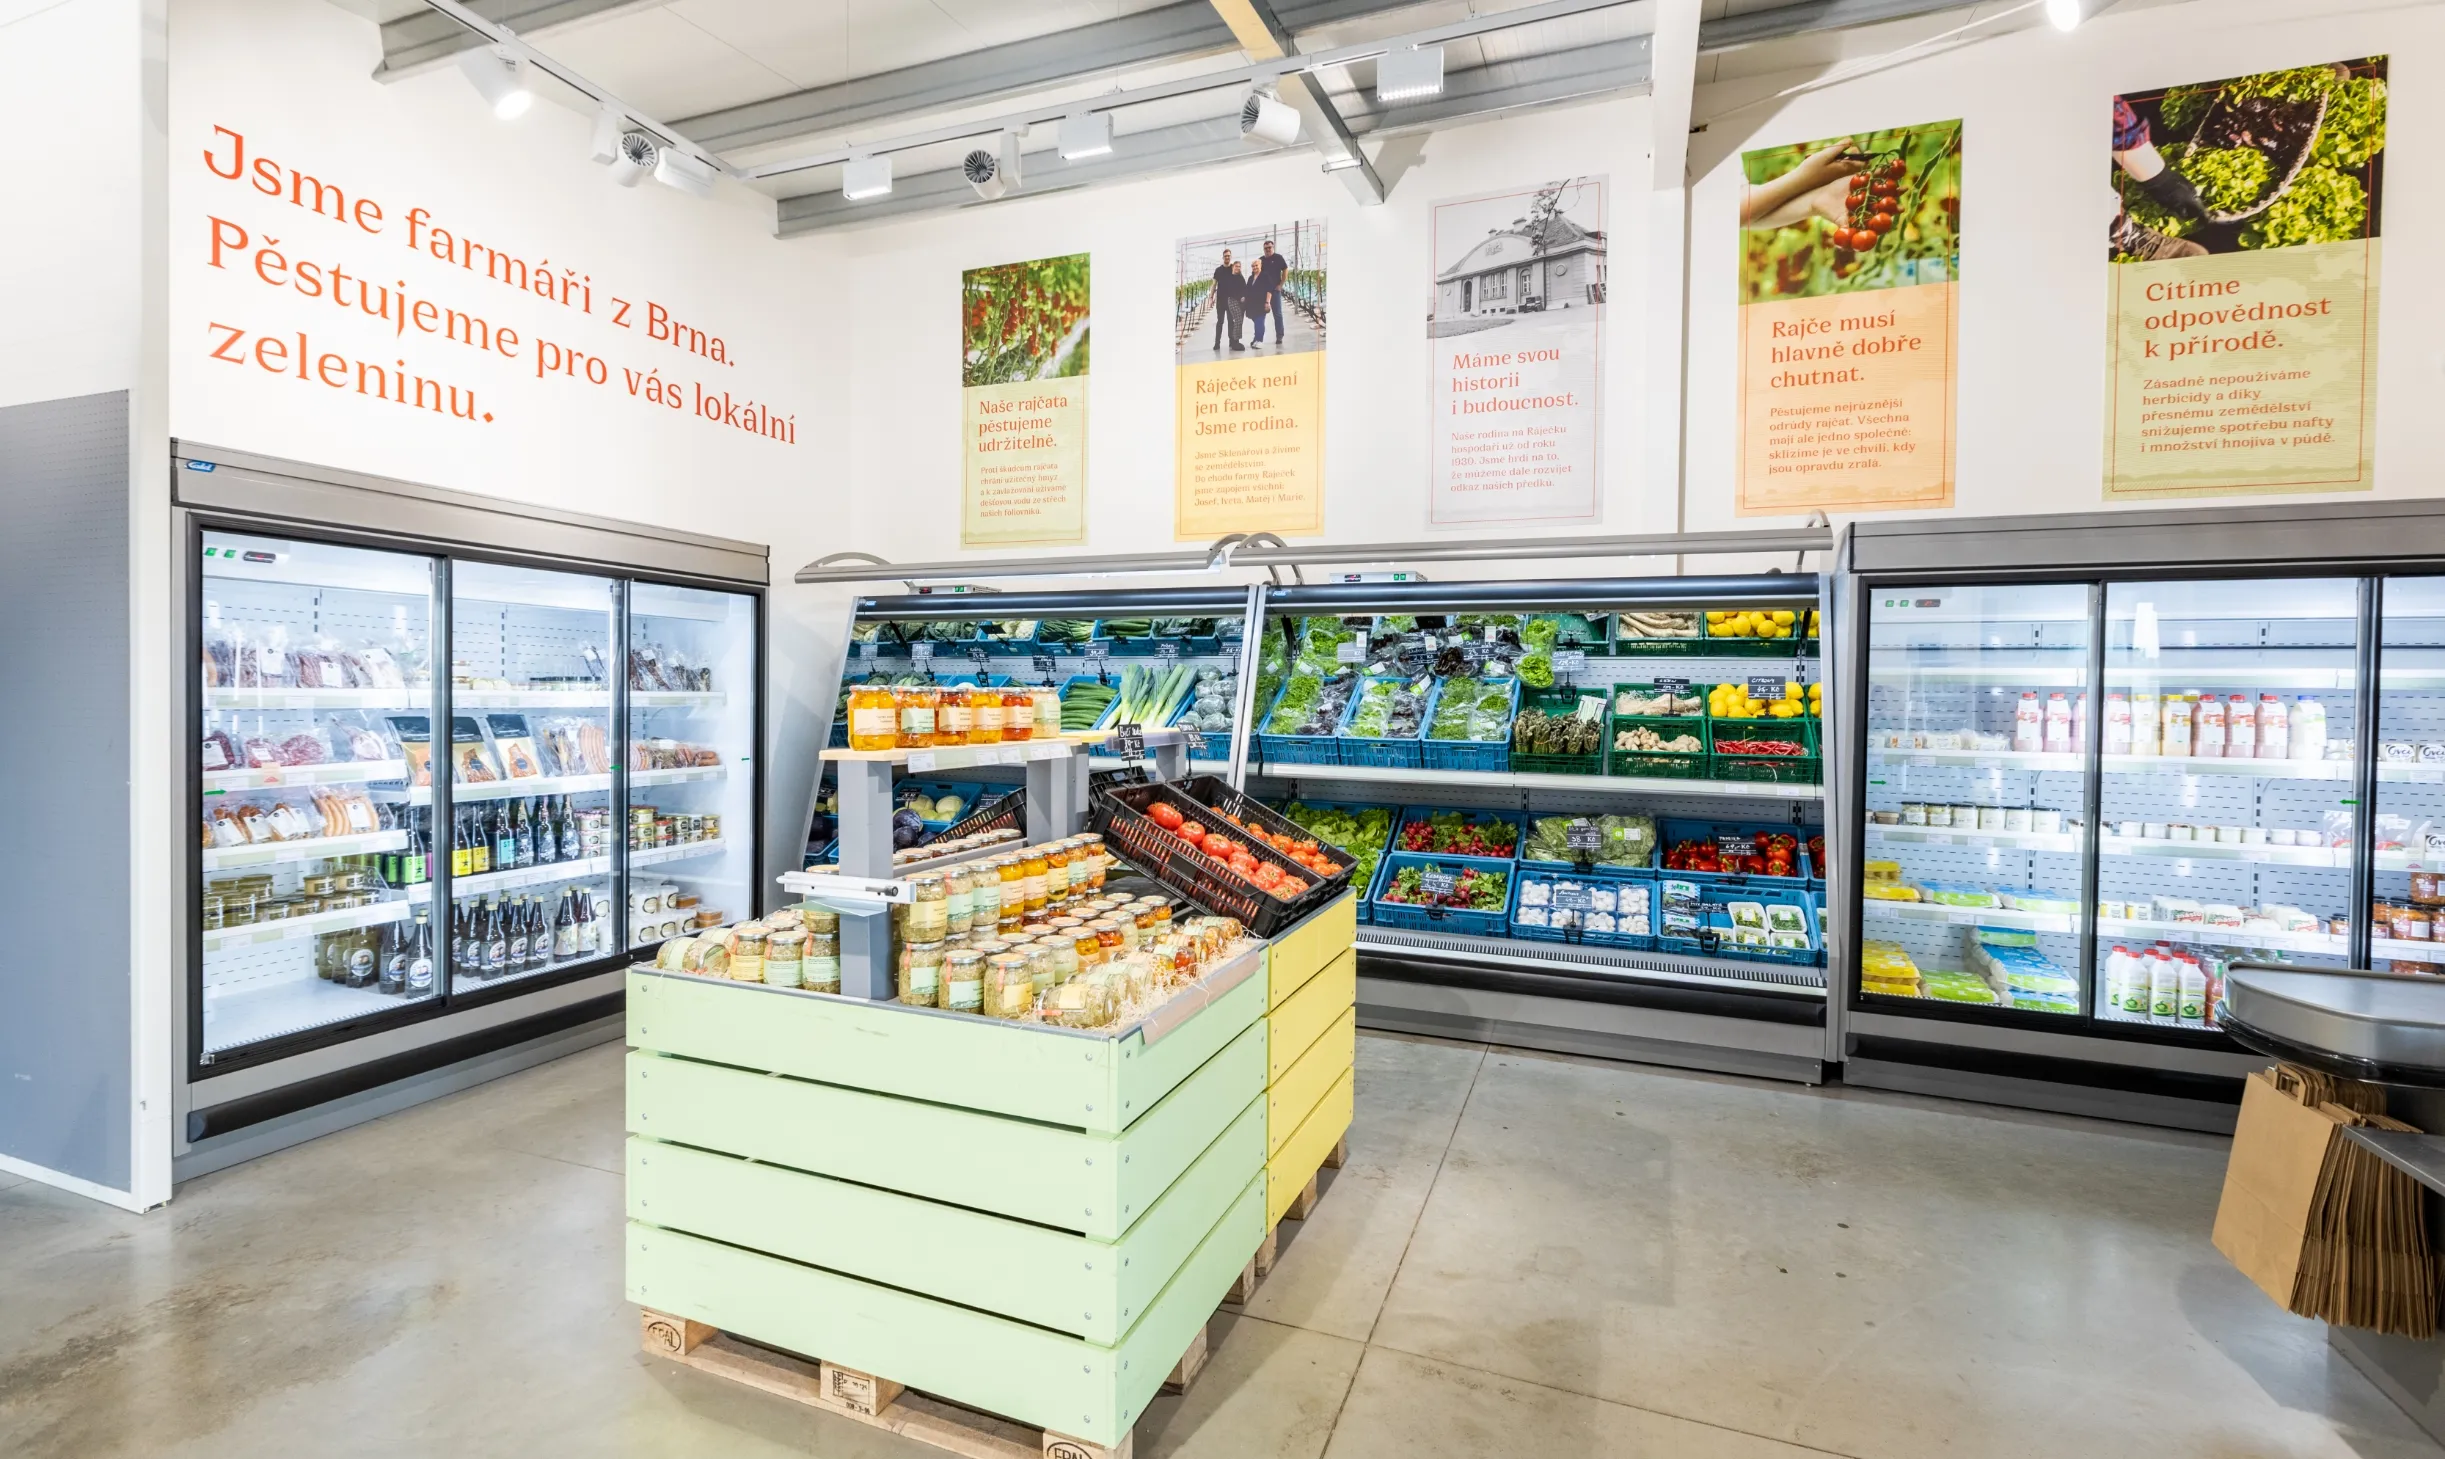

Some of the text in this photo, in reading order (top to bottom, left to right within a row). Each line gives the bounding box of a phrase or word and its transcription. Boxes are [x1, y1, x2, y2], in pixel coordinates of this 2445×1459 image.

[203, 123, 736, 367] Jsme farmáři z Brna.
[2146, 279, 2241, 302] Cítíme
[1771, 308, 1896, 341] Rajče musí
[2144, 297, 2332, 332] odpovědnost
[206, 215, 796, 445] Pěstujeme pro vás lokální
[1771, 334, 1922, 364] hlavně dobře
[2144, 329, 2284, 361] k přírodě.
[1452, 348, 1560, 370] Máme svou
[208, 320, 496, 424] zeleninu.
[1452, 371, 1520, 393] historii
[1770, 366, 1865, 389] chutnat.
[2143, 369, 2312, 391] Zásadně nepoužíváme
[1196, 370, 1298, 398] Ráječek není
[979, 395, 1068, 415] Naše rajčata
[1195, 398, 1275, 420] jen farma.
[1451, 391, 1579, 415] i budoucnost.
[2142, 391, 2211, 406] herbicidy
[2215, 392, 2225, 401] a
[1769, 405, 1831, 417] Pěstujeme
[2141, 400, 2312, 424] přesnému zemědělství
[978, 416, 1052, 437] pěstujeme
[1195, 415, 1298, 436] Jsme rodina.
[1769, 420, 1812, 432] odrůdy
[1857, 413, 1910, 425] Všechna
[2141, 416, 2335, 438] snižujeme spotřebu nafty
[978, 433, 1057, 453] udržitelně.
[1451, 431, 1475, 441] Naše
[1477, 429, 1509, 439] rodina
[1511, 428, 1524, 437] na
[1502, 441, 1514, 450] už
[1517, 440, 1530, 449] od
[1532, 439, 1556, 449] roku
[1797, 434, 1814, 444] ale
[1817, 432, 1851, 444] jedno
[2140, 443, 2145, 453] i
[2149, 438, 2217, 453] množství
[2222, 438, 2275, 449] hnojiva
[2280, 436, 2289, 446] v
[1478, 455, 1506, 465] Jsme
[1531, 452, 1544, 462] na
[1822, 446, 1833, 458] je
[1836, 446, 1850, 455] ve
[1893, 441, 1916, 453] kdy
[1768, 464, 1792, 476] jsou
[1795, 460, 1844, 474] opravdu
[1450, 482, 1480, 492] odkaz
